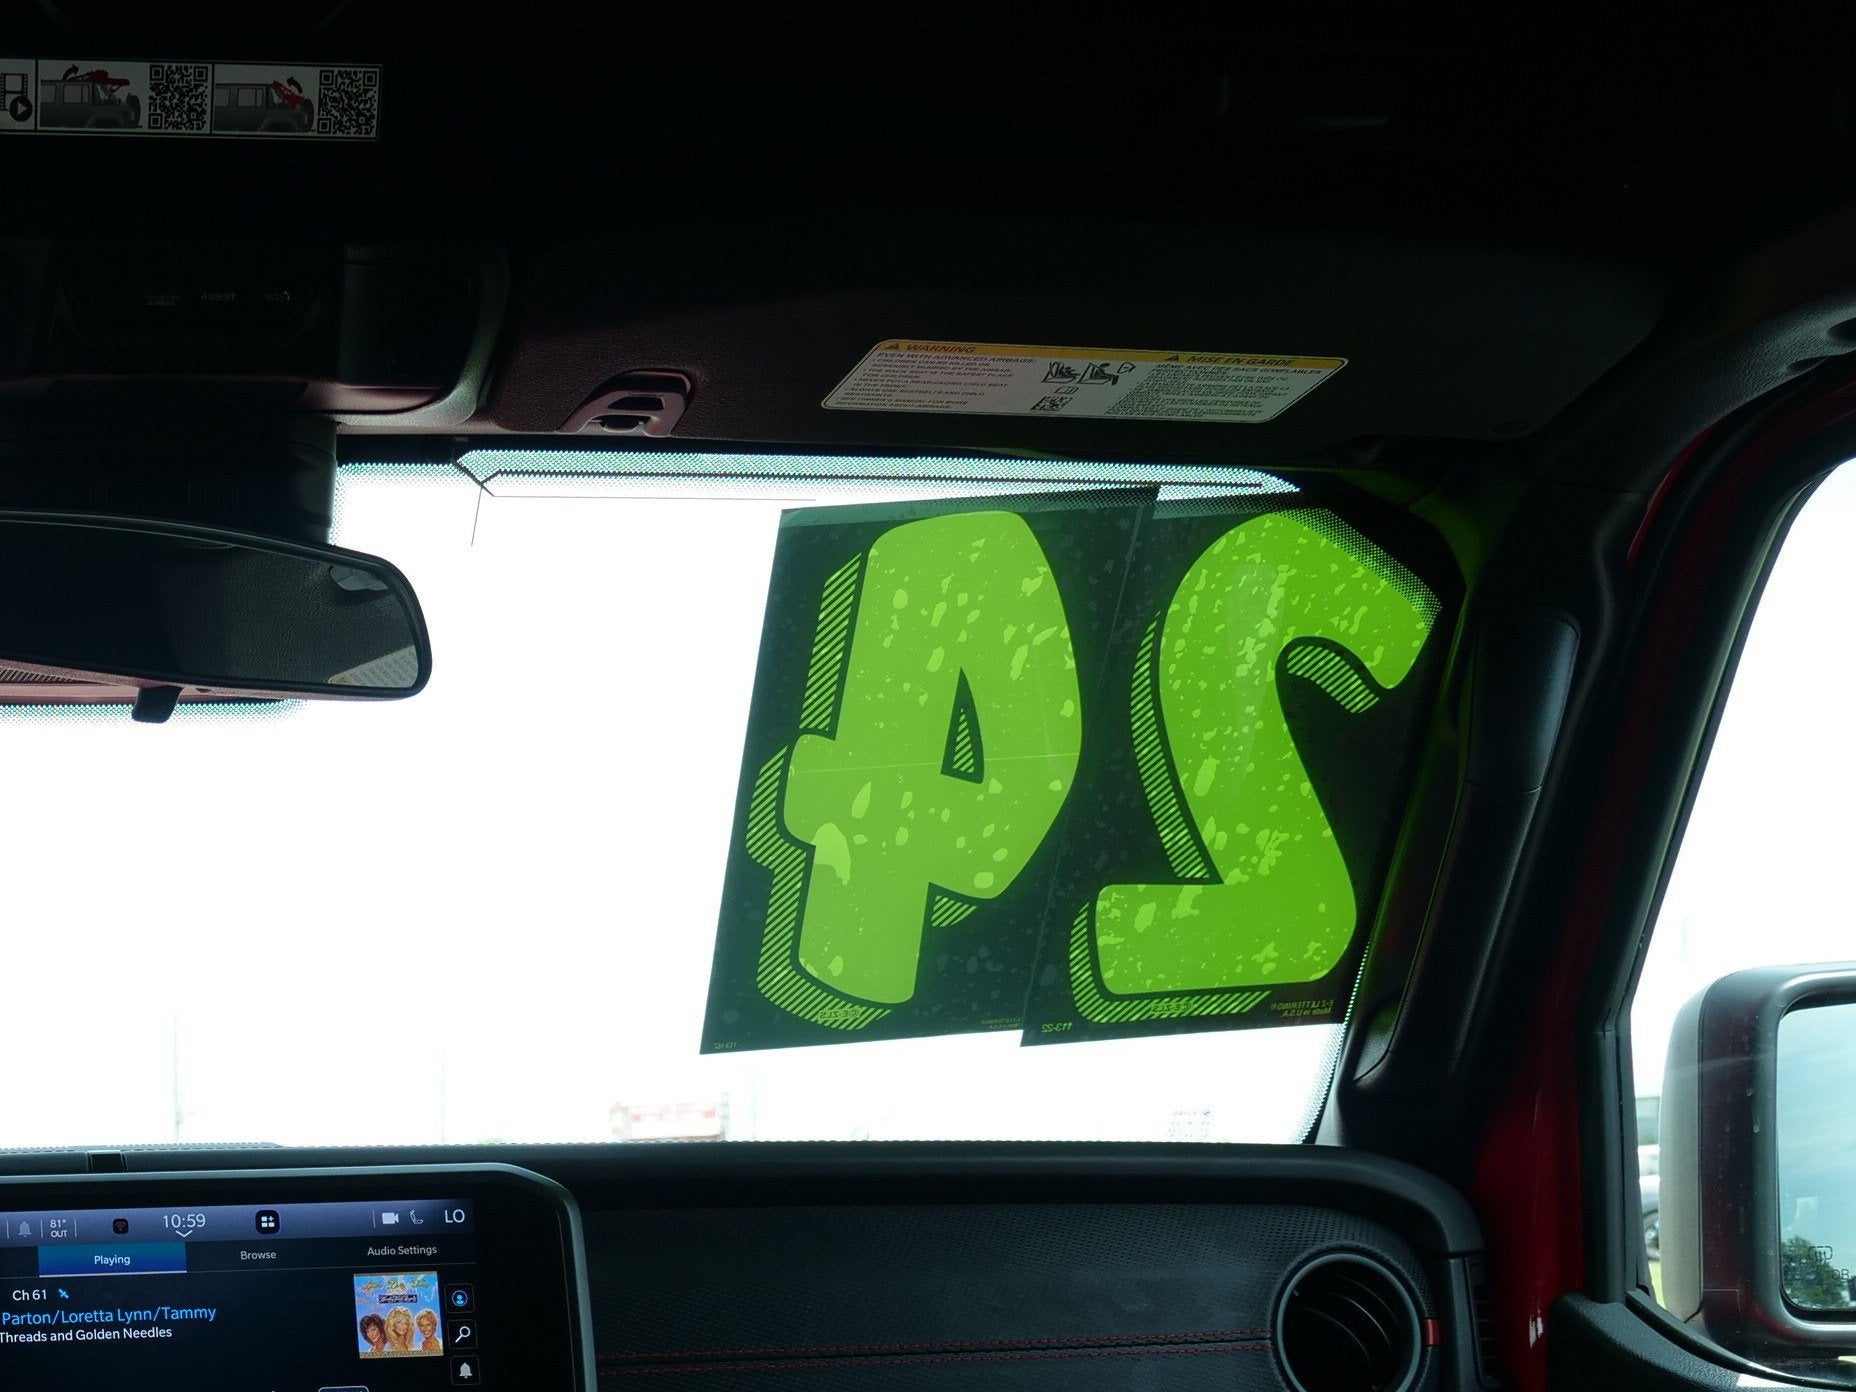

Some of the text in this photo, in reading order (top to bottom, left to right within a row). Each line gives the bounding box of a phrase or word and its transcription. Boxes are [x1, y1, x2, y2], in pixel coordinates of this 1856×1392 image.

[906, 344, 976, 353] WARNING
[1247, 358, 1297, 366] GARDE
[162, 1213, 207, 1229] 10:59
[444, 1209, 466, 1224] LO
[50, 1229, 68, 1238] OUT
[240, 1250, 277, 1260] Browse
[367, 1244, 438, 1257] Audio Settings
[94, 1254, 131, 1267] Playing
[12, 1289, 48, 1301] Ch 61
[2, 1309, 114, 1326] Parton/Loretta
[117, 1306, 217, 1325] Lynn/Tammy
[49, 1329, 73, 1342] and
[75, 1328, 121, 1341] Golden
[122, 1326, 173, 1339] Needles
